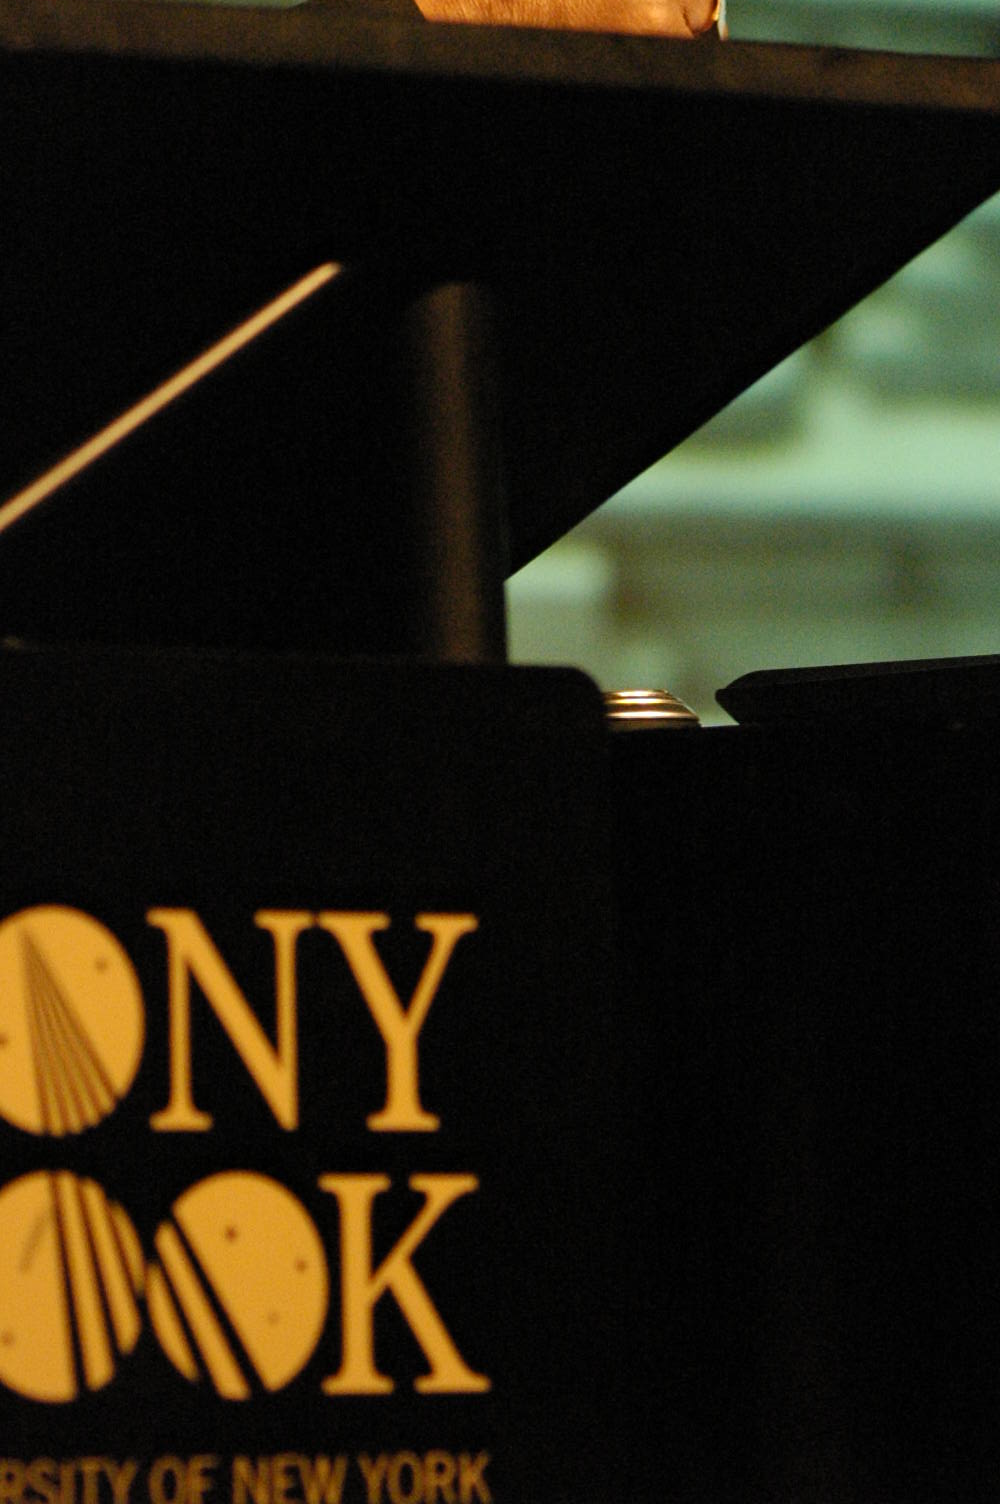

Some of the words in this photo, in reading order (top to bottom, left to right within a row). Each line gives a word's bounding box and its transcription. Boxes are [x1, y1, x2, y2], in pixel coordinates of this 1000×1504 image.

[148, 1454, 217, 1504] OF
[231, 1452, 348, 1504] NEW
[357, 1450, 490, 1504] YORK
